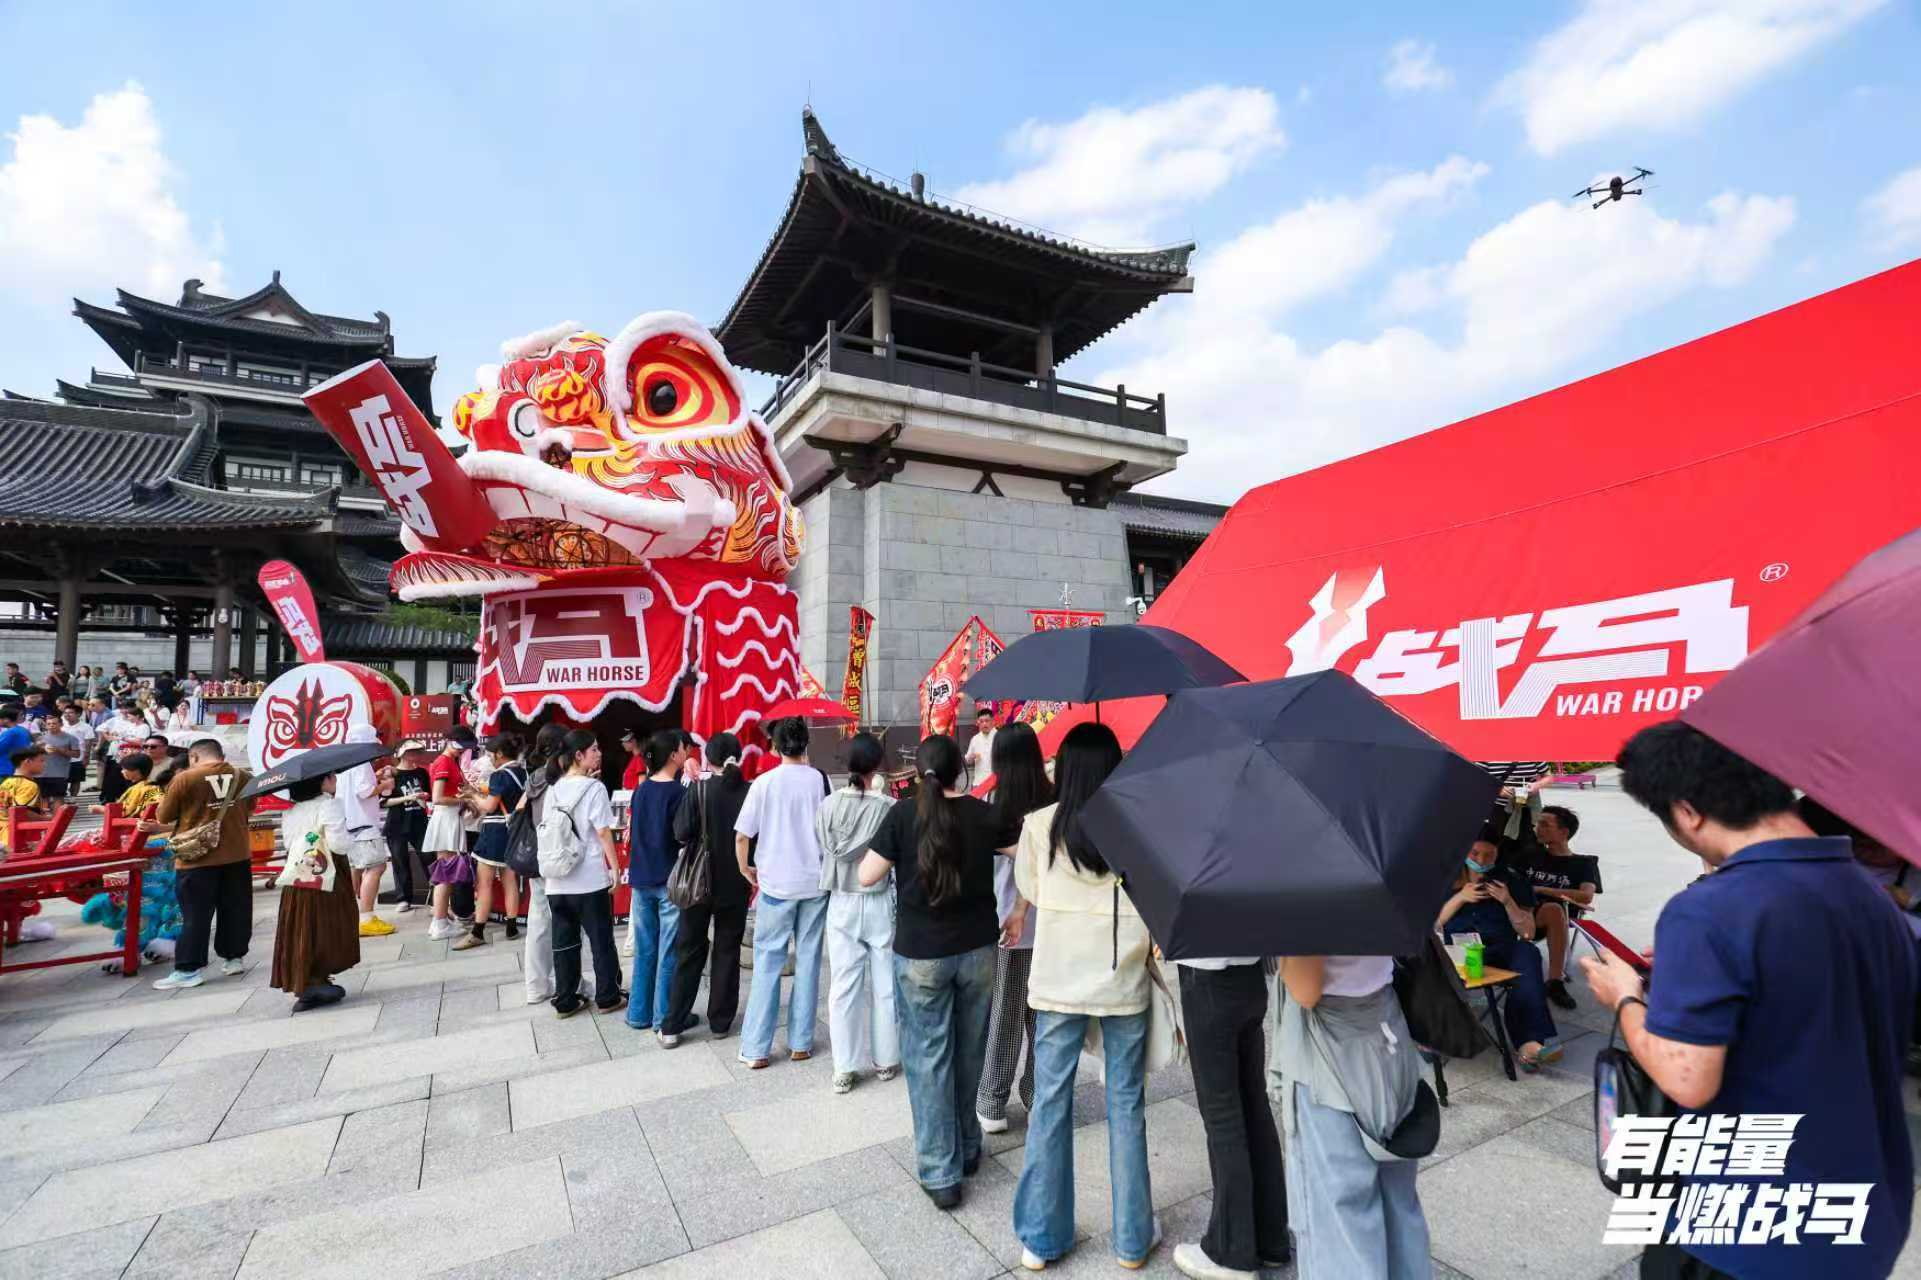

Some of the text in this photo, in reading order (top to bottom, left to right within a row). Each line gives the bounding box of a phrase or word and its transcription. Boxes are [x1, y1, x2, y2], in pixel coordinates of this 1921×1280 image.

[349, 394, 440, 538] 战马
[1352, 578, 1750, 720] 战马
[546, 665, 645, 684] WAR HORSE
[1556, 685, 1704, 717] WAR HOR
[205, 773, 233, 800] V
